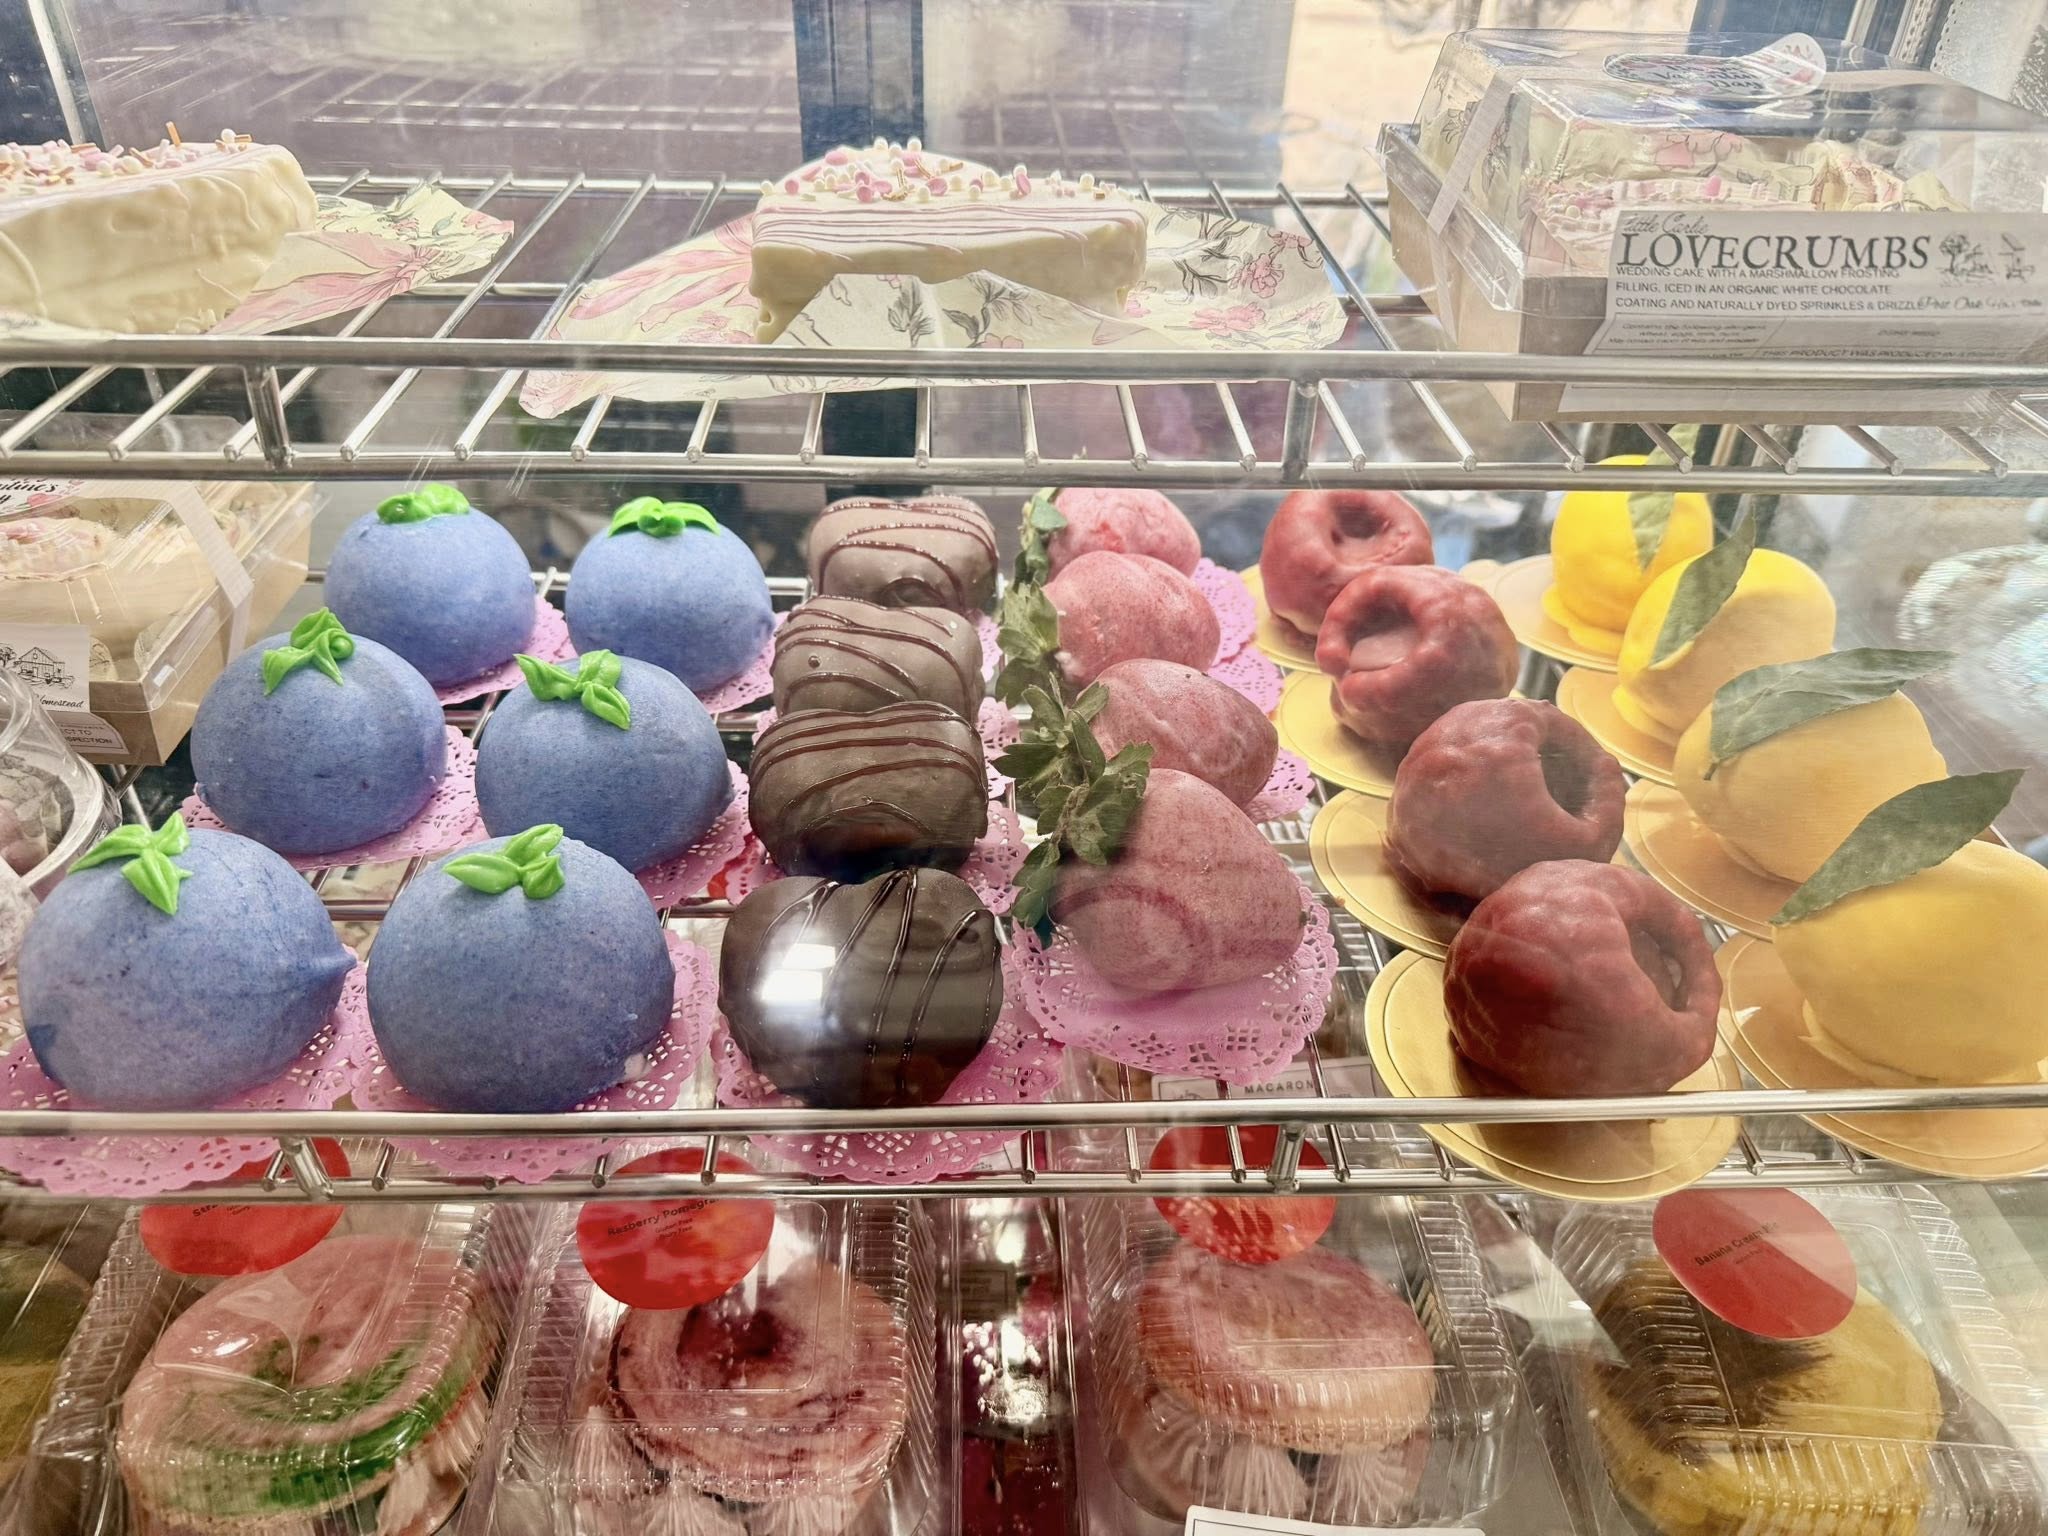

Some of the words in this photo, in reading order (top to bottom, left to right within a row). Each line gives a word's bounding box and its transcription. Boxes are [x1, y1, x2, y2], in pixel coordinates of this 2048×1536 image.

[1617, 233, 1931, 270] LOVECRUMBS
[1616, 266, 1671, 277] WEDDING
[1673, 267, 1705, 278] CAKE
[1707, 268, 1736, 279] WITH
[1739, 268, 1747, 279] A
[1749, 268, 1838, 279] MARSHMALLOW
[1841, 268, 1900, 279] FROSTING
[1664, 283, 1692, 293] ICED
[1695, 284, 1706, 293] IN
[1709, 284, 1725, 294] AN
[1727, 284, 1779, 295] ORGANIC
[1782, 285, 1818, 295] WHITE
[1821, 284, 1892, 295] CHOCOLATE
[1615, 297, 1667, 309] COATING
[1670, 298, 1695, 309] AND
[1697, 298, 1763, 311] NATURALLY
[1766, 300, 1798, 311] DYED
[1801, 300, 1865, 311] SPRINKLES
[1867, 301, 1874, 311] &
[1877, 300, 1923, 311] DRIZZLE
[608, 1214, 660, 1236] Rasberry
[1694, 1244, 1733, 1267] Banana
